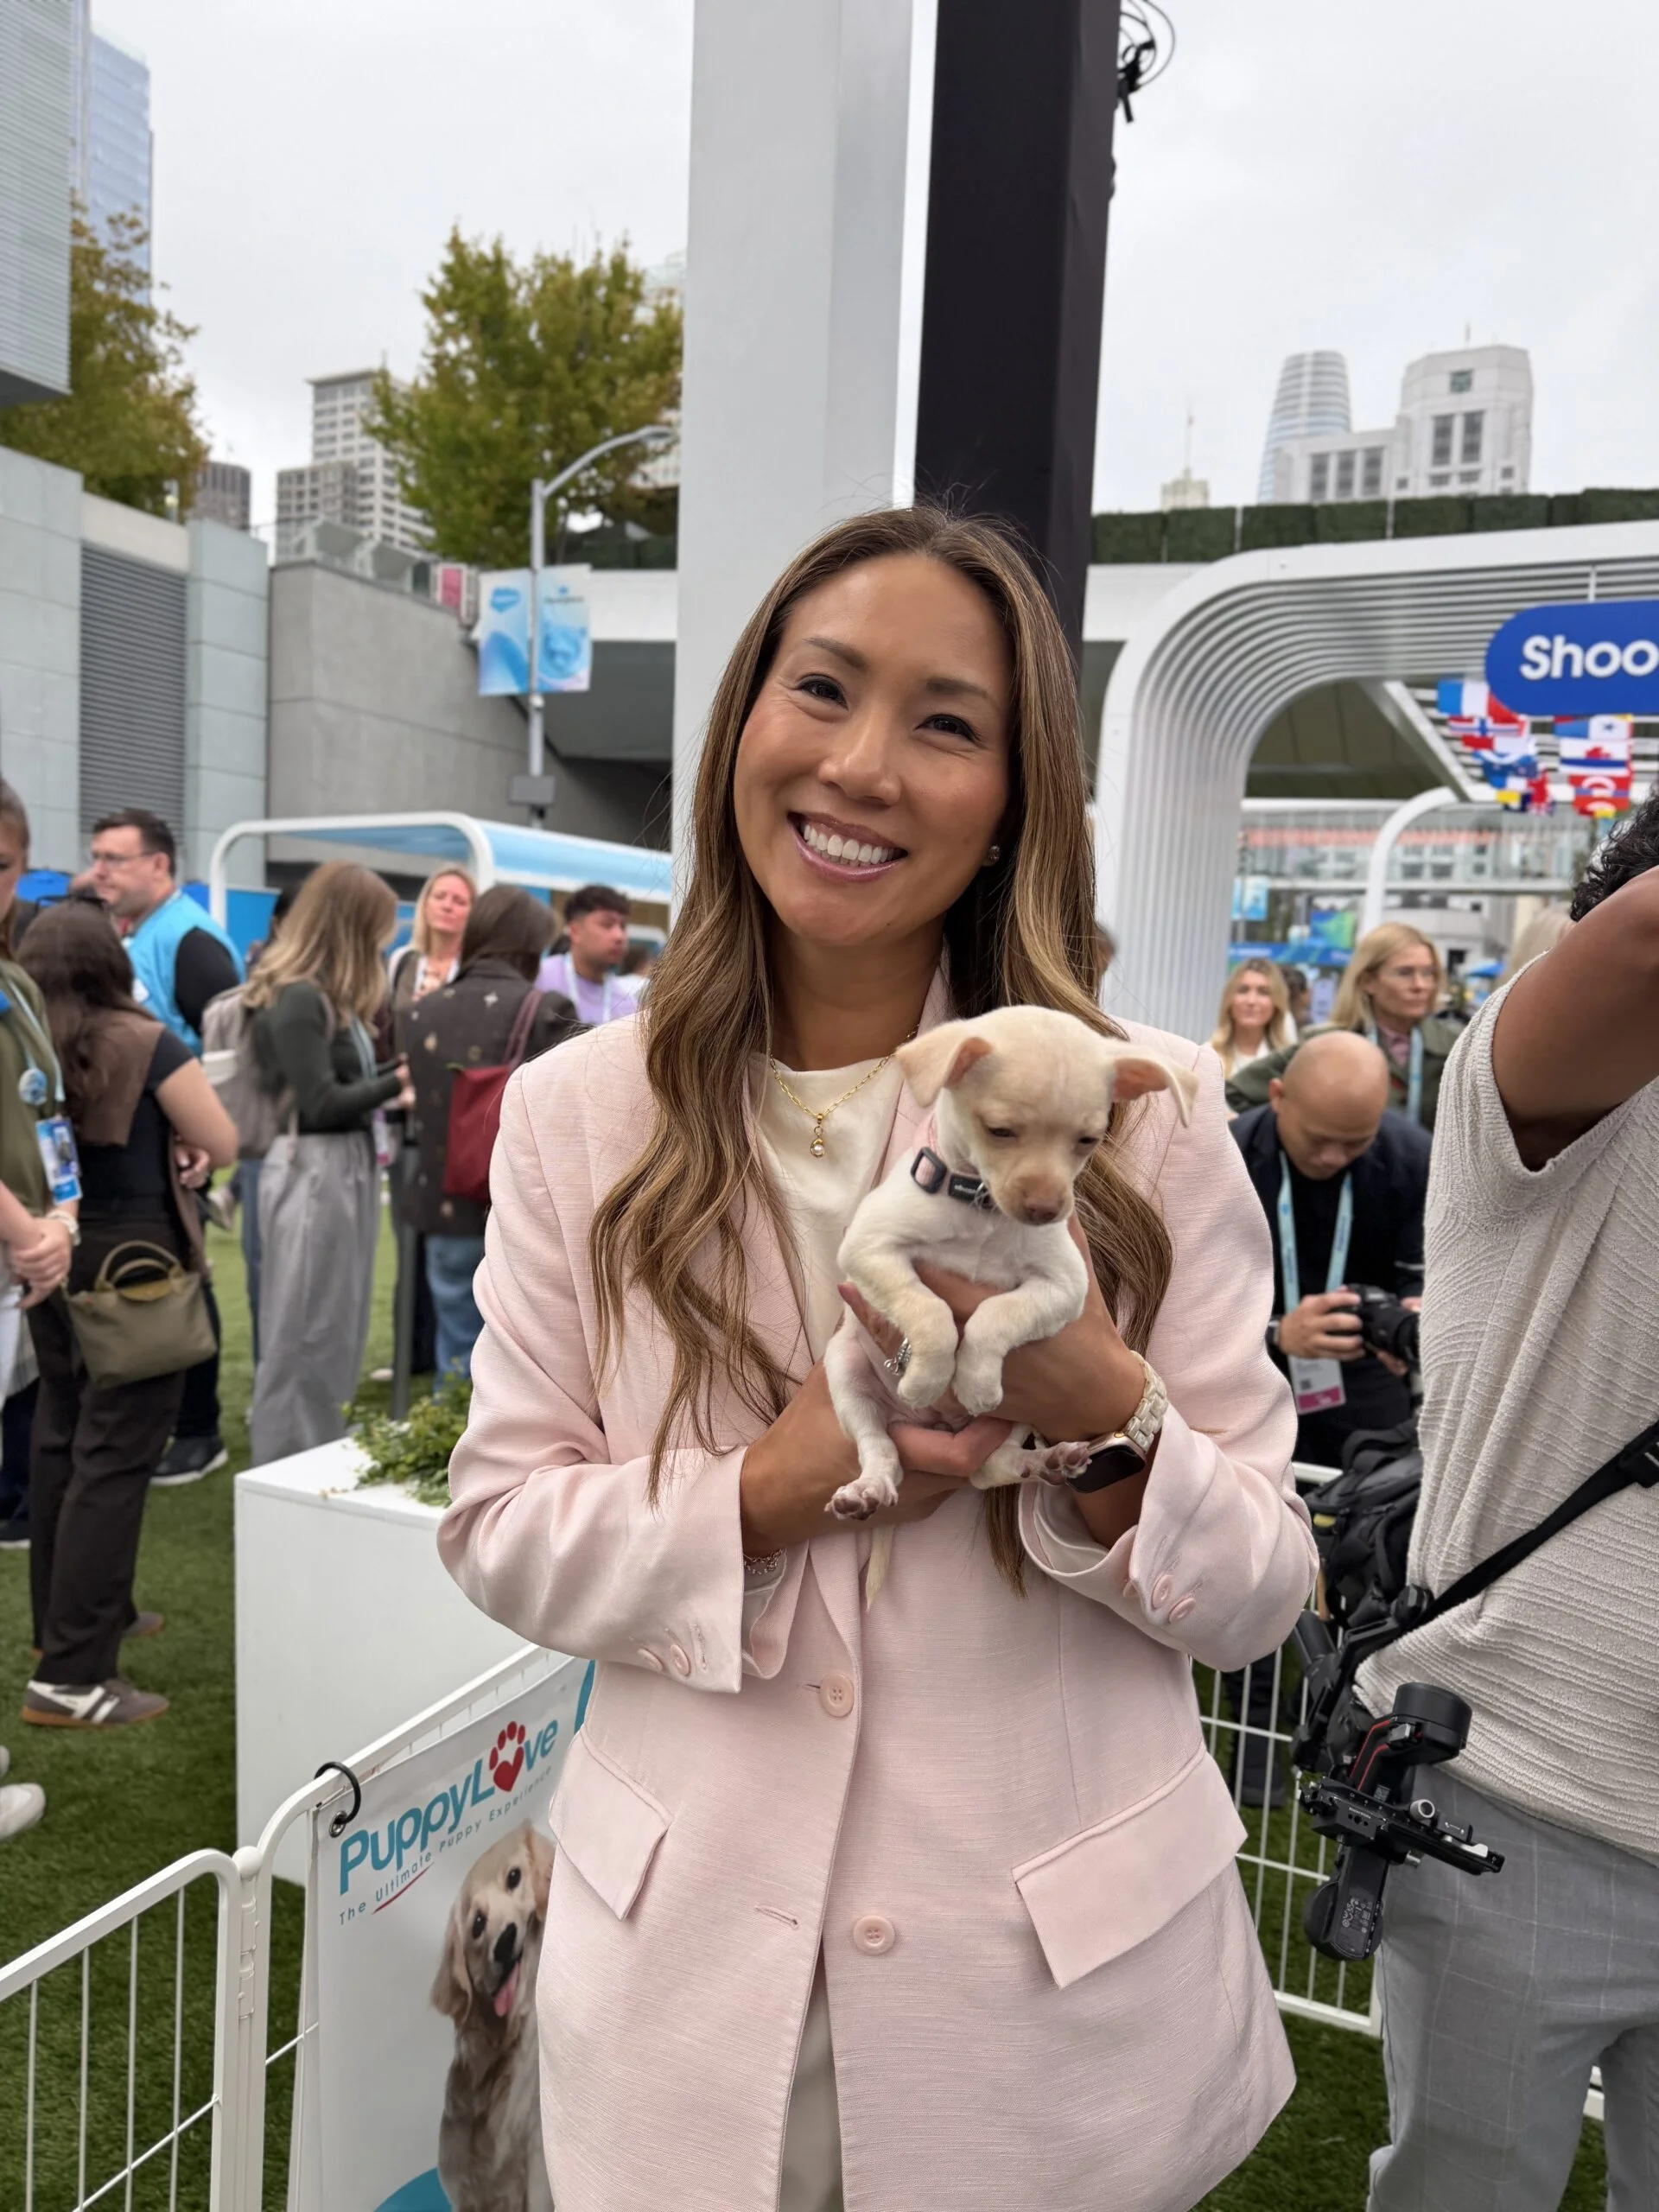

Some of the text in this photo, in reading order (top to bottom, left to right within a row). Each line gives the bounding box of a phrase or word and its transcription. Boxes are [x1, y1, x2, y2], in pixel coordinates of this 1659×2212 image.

[1519, 634, 1659, 681] Shoo
[340, 1901, 366, 1926] The
[375, 1852, 431, 1903] Ultimate
[488, 1765, 552, 1822] Experience
